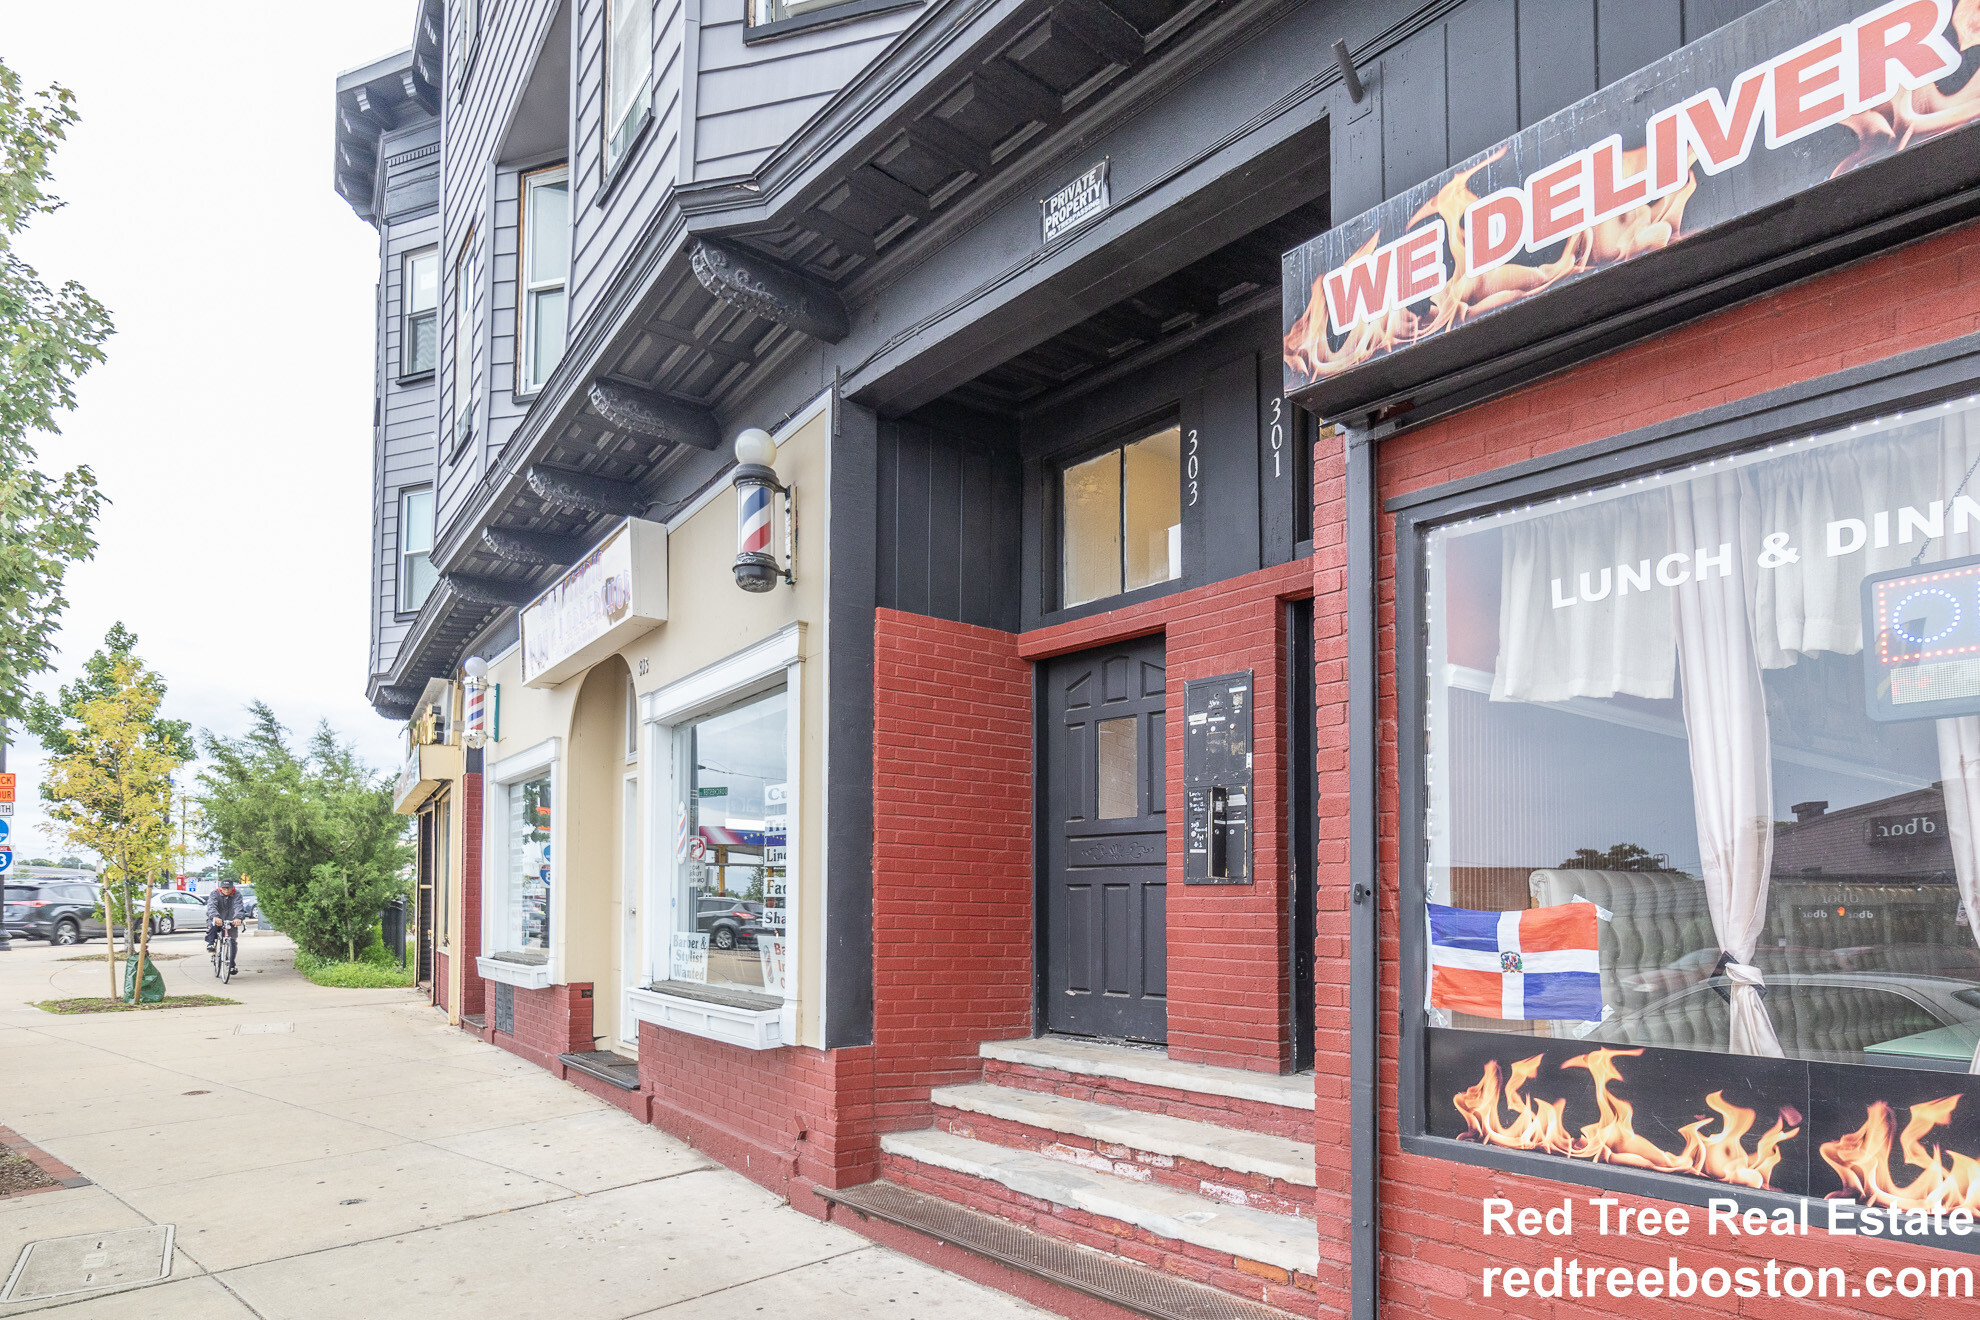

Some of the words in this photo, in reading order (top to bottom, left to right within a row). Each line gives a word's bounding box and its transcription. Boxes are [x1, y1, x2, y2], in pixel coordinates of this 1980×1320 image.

[1327, 225, 1445, 331] WE
[1470, 0, 1946, 273] DELIVER
[1045, 180, 1101, 233] PROPERTY
[1050, 169, 1097, 214] PRIVATE
[1047, 228, 1057, 239] NO
[1057, 198, 1100, 230] TRESPASSING
[1270, 397, 1283, 478] 301
[1188, 429, 1199, 507] 303
[1551, 542, 1732, 610] LUNCH
[1756, 531, 1801, 569] &
[673, 934, 699, 949] Barber
[701, 936, 707, 950] &
[676, 949, 703, 965] Stylist
[674, 964, 705, 981] Wanted
